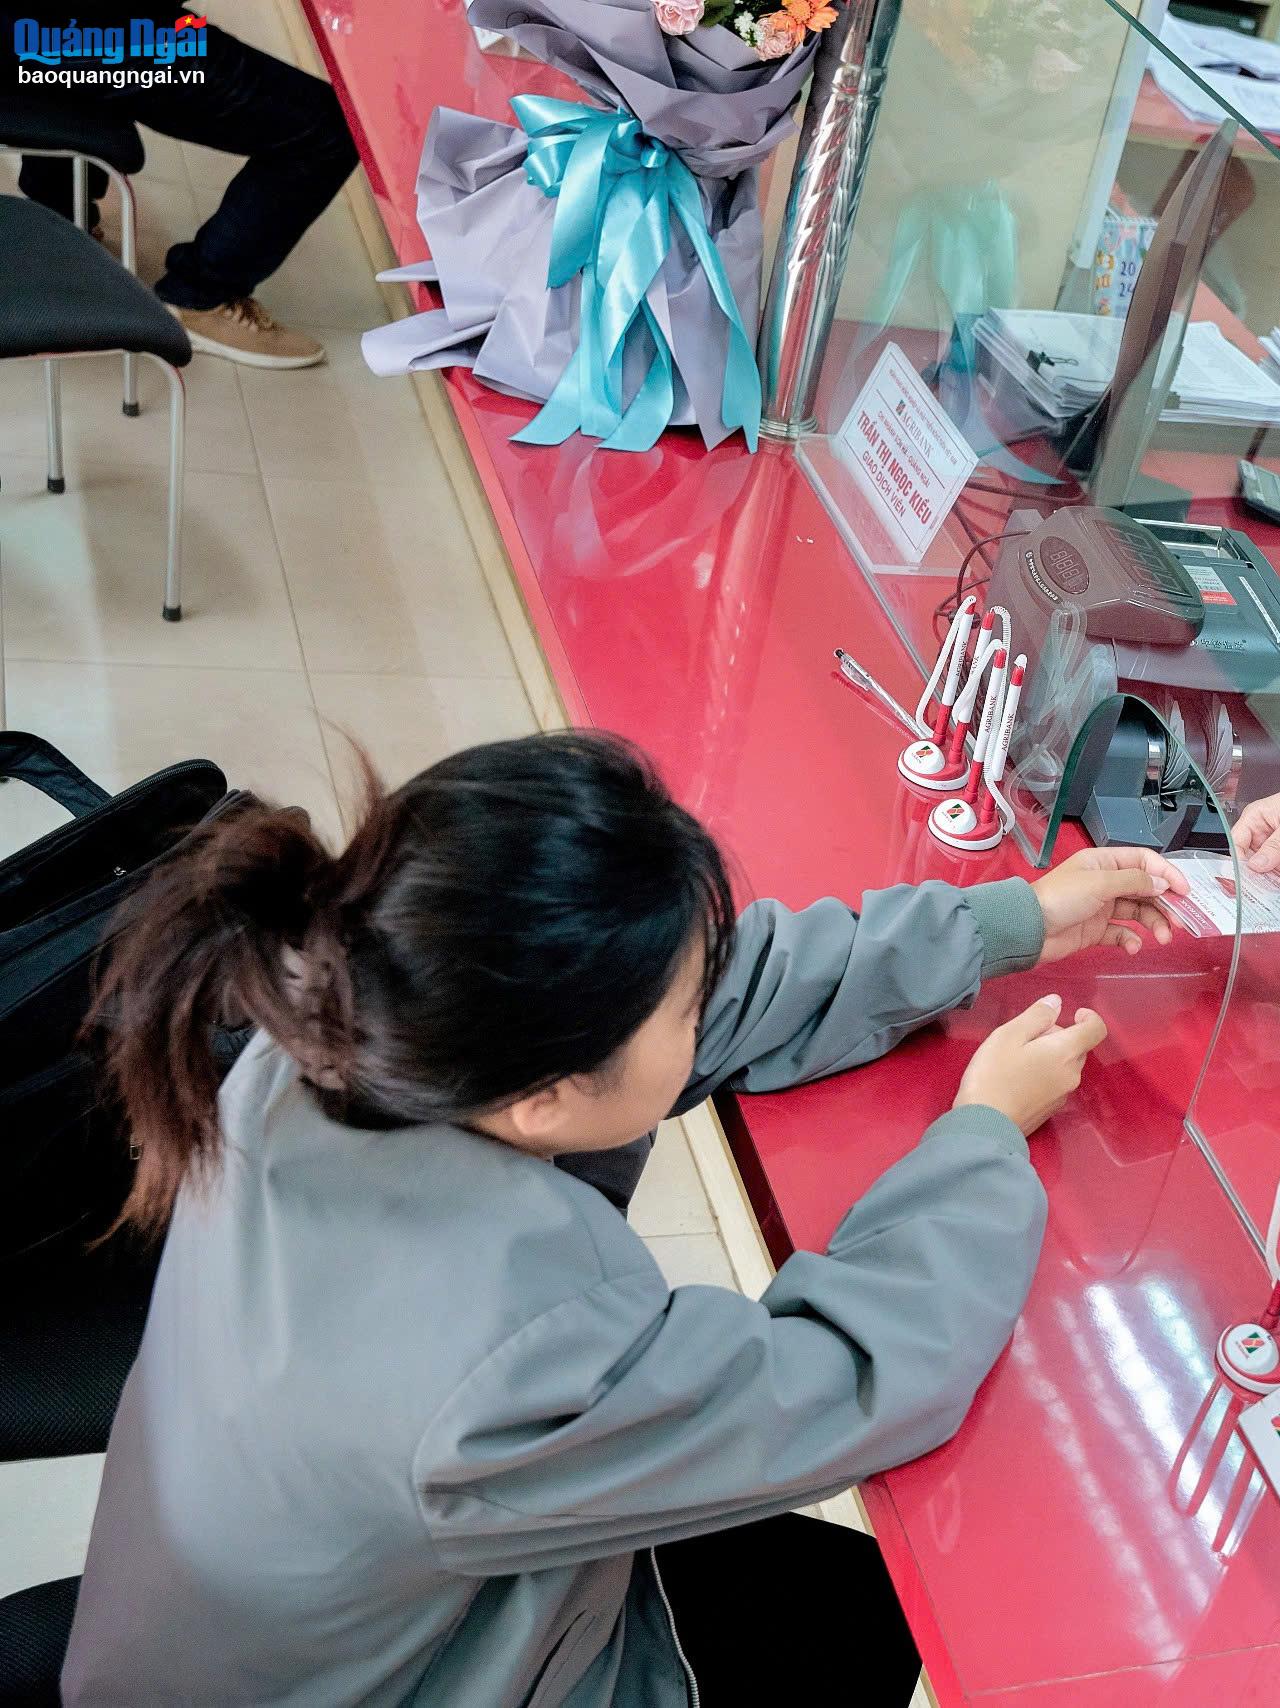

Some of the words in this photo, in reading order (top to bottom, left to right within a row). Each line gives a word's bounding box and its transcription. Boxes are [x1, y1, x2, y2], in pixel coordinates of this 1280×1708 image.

[900, 411, 934, 459] AGRIBANK
[861, 448, 878, 475] GIAO
[875, 469, 892, 497] DỊCH
[889, 491, 906, 517] VIÊN
[875, 438, 892, 469] THỊ
[887, 457, 913, 498] NGỌC
[956, 641, 967, 677] AGRIBANK
[985, 696, 997, 733] AGRIBANK
[1002, 714, 1015, 751] AGRIBANK
